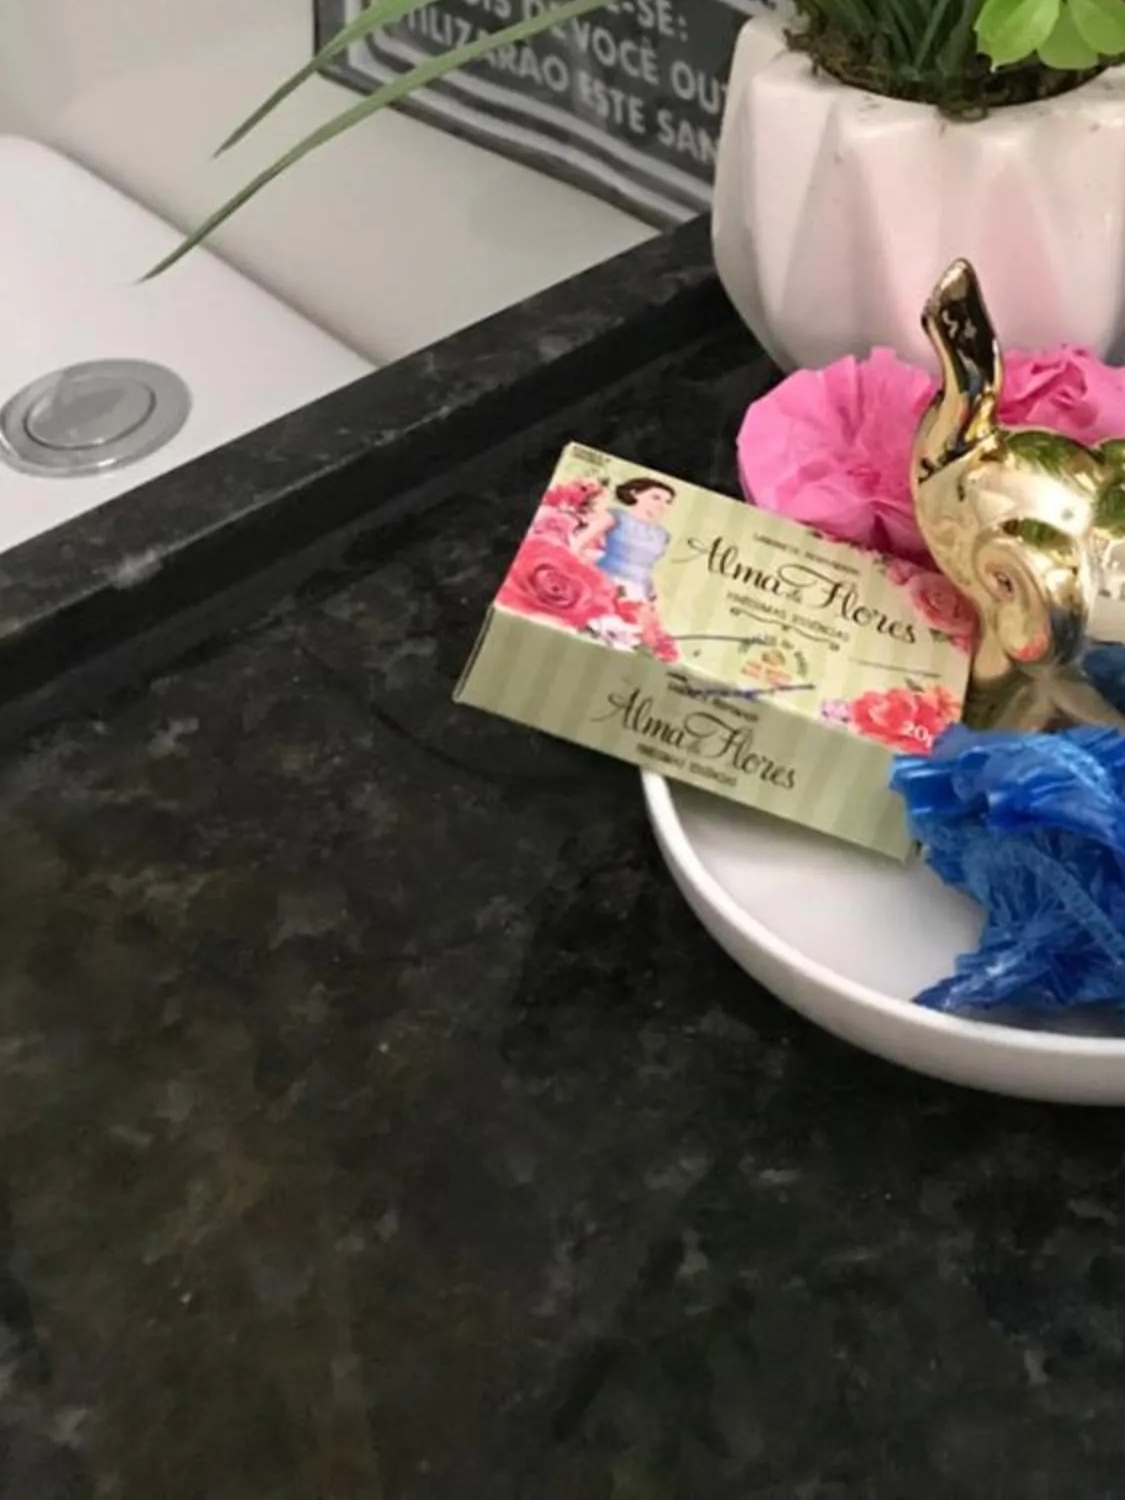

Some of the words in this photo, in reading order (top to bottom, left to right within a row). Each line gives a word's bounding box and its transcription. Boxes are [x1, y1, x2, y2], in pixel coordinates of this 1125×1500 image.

[572, 15, 660, 85] VOCÊ
[577, 70, 646, 135] ESTE
[671, 535, 784, 599] Alma
[776, 563, 917, 645] Flores
[590, 686, 687, 751] Alma
[682, 709, 797, 791] Flores
